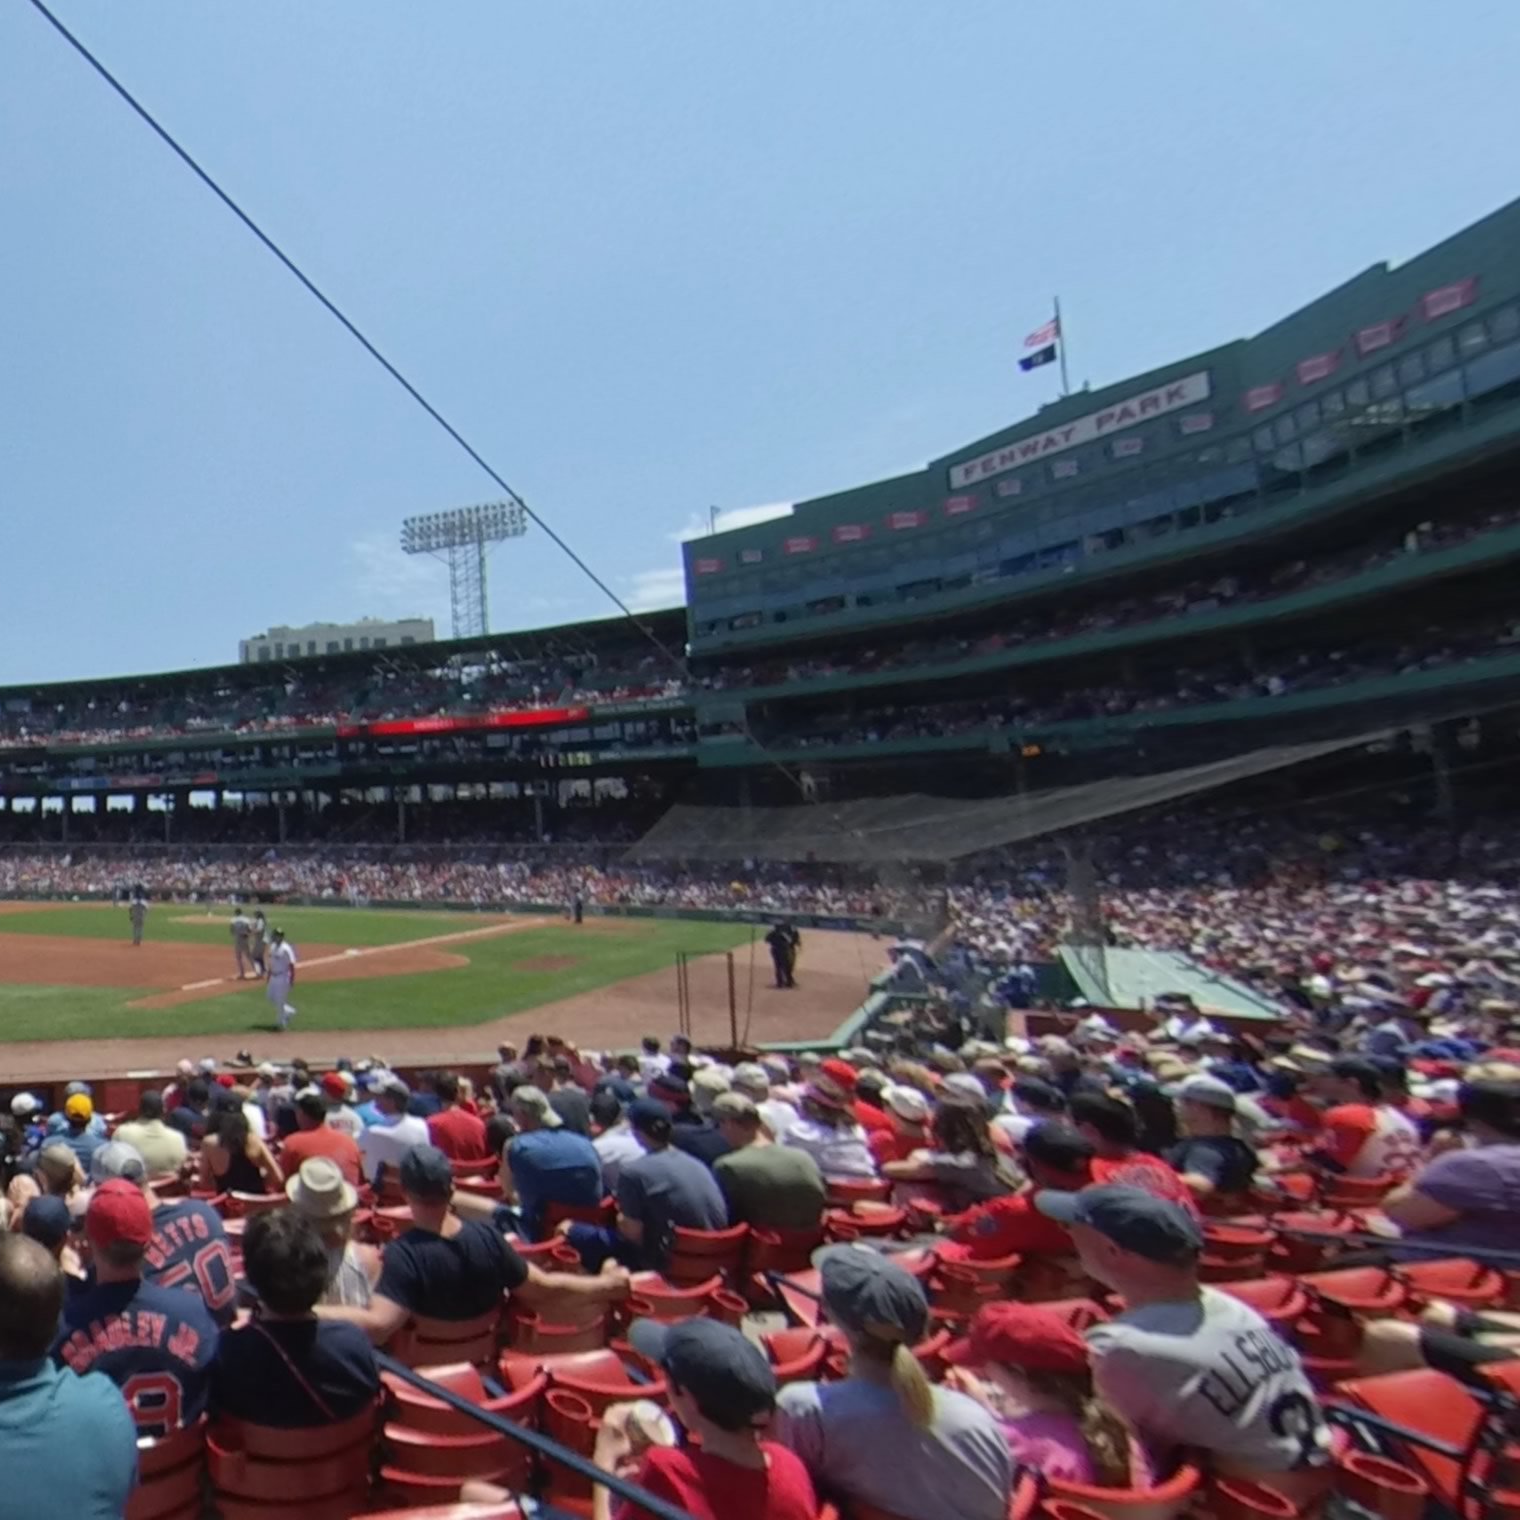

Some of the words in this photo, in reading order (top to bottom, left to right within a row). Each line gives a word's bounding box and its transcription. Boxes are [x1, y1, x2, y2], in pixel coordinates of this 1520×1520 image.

[962, 427, 1077, 481] FENWAY
[1094, 384, 1187, 431] PARK
[144, 1213, 209, 1269] BETTS
